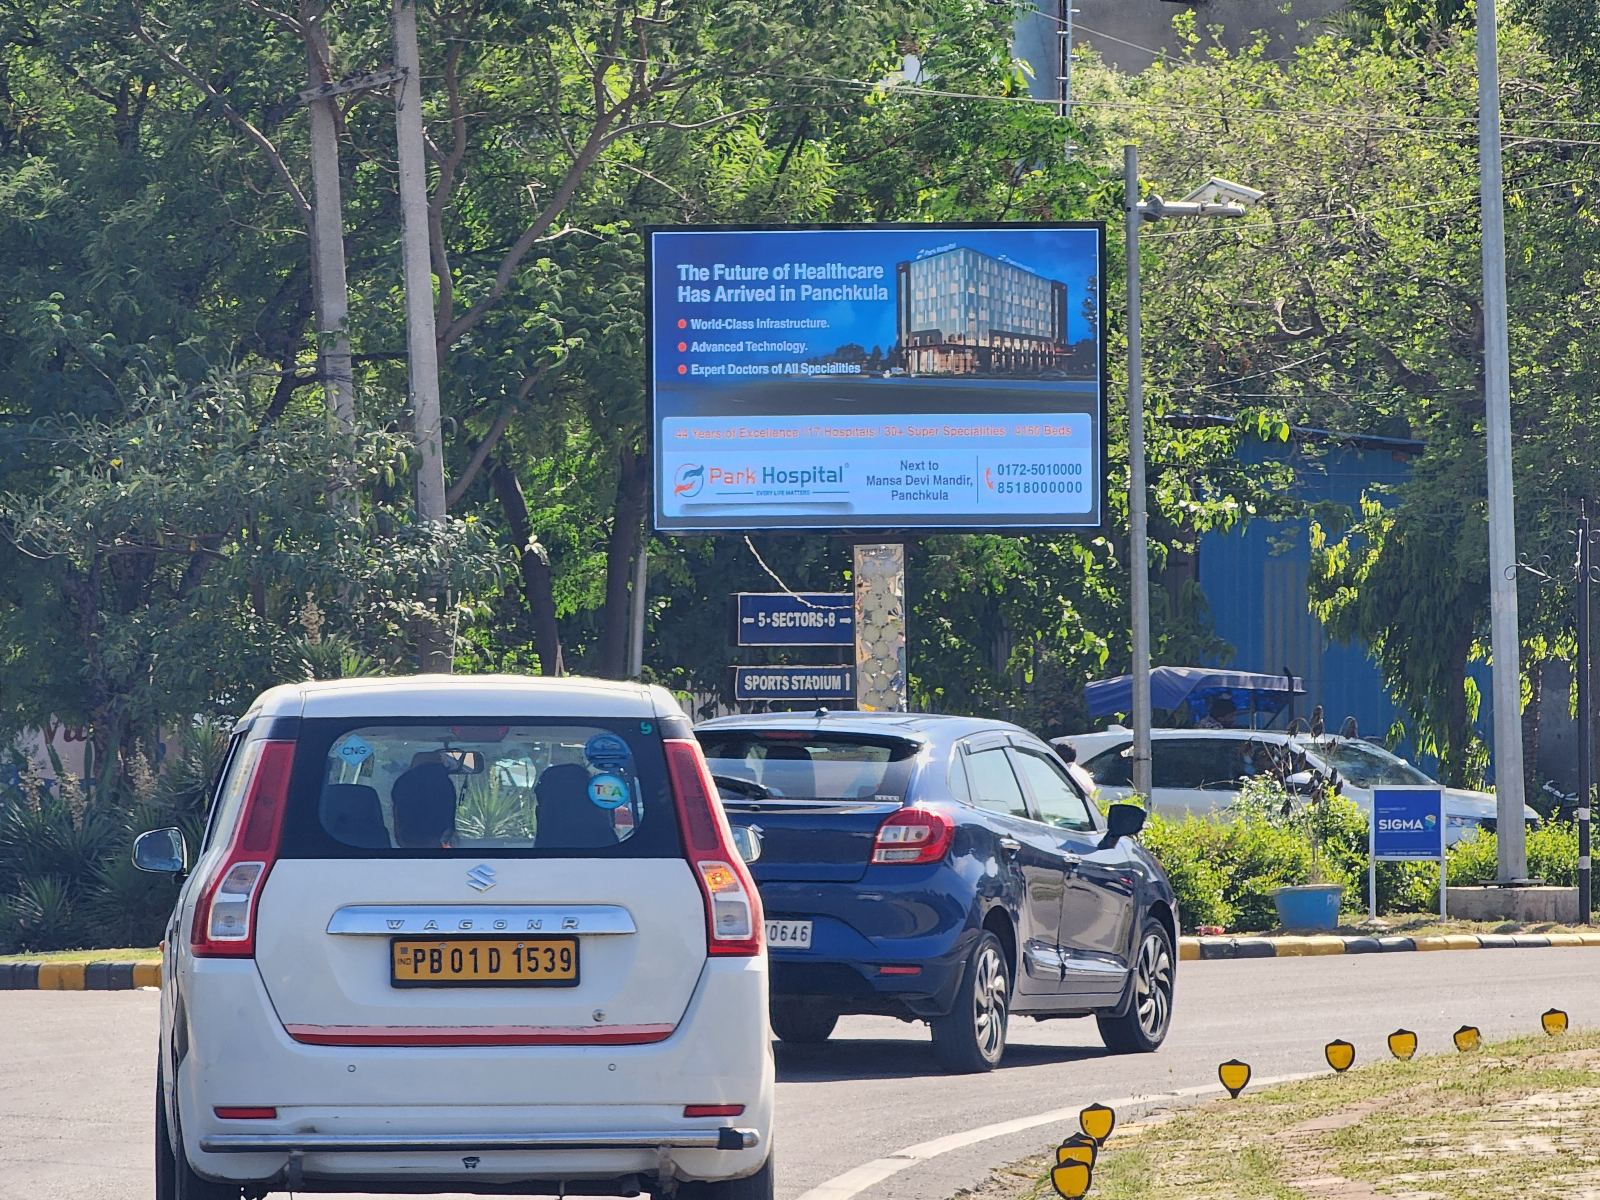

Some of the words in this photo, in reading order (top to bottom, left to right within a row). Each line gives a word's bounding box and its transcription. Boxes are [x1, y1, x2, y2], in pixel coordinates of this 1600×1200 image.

[677, 264, 709, 281] The
[714, 263, 769, 281] Future
[773, 262, 790, 280] of
[794, 262, 884, 280] Healthcare
[677, 285, 711, 303] Has
[714, 285, 775, 302] Arrived
[780, 284, 796, 302] in
[801, 284, 888, 301] Panchkula
[690, 318, 754, 330] World-Class
[756, 317, 830, 329] Infrastructure.
[690, 341, 743, 353] Advanced
[745, 341, 808, 354] Technology.
[690, 364, 725, 377] Expert
[728, 363, 769, 375] Doctors
[771, 363, 782, 375] of
[784, 363, 799, 375] All
[800, 362, 861, 377] Specialities
[693, 428, 721, 439] Years
[725, 427, 736, 438] of
[739, 427, 800, 438] Excellence
[824, 425, 876, 438] Hospitals
[907, 425, 938, 439] Super
[943, 424, 1005, 437] Specialities
[1043, 424, 1073, 437] Beds
[900, 460, 925, 471] Next
[928, 460, 939, 471] to
[997, 463, 1082, 477] 0172-5010000
[709, 467, 756, 485] Park
[762, 465, 843, 487] Hospital
[866, 475, 902, 487] Mansa
[905, 475, 930, 486] Devi
[933, 474, 973, 487] Mandir,
[997, 481, 1082, 494] 8518000000
[891, 489, 949, 501] Panchkula
[744, 675, 790, 691] SPORTS
[791, 675, 841, 690] STADIUM
[342, 745, 367, 756] CNG
[1378, 818, 1424, 830] SIGMA
[765, 924, 809, 942] 0646
